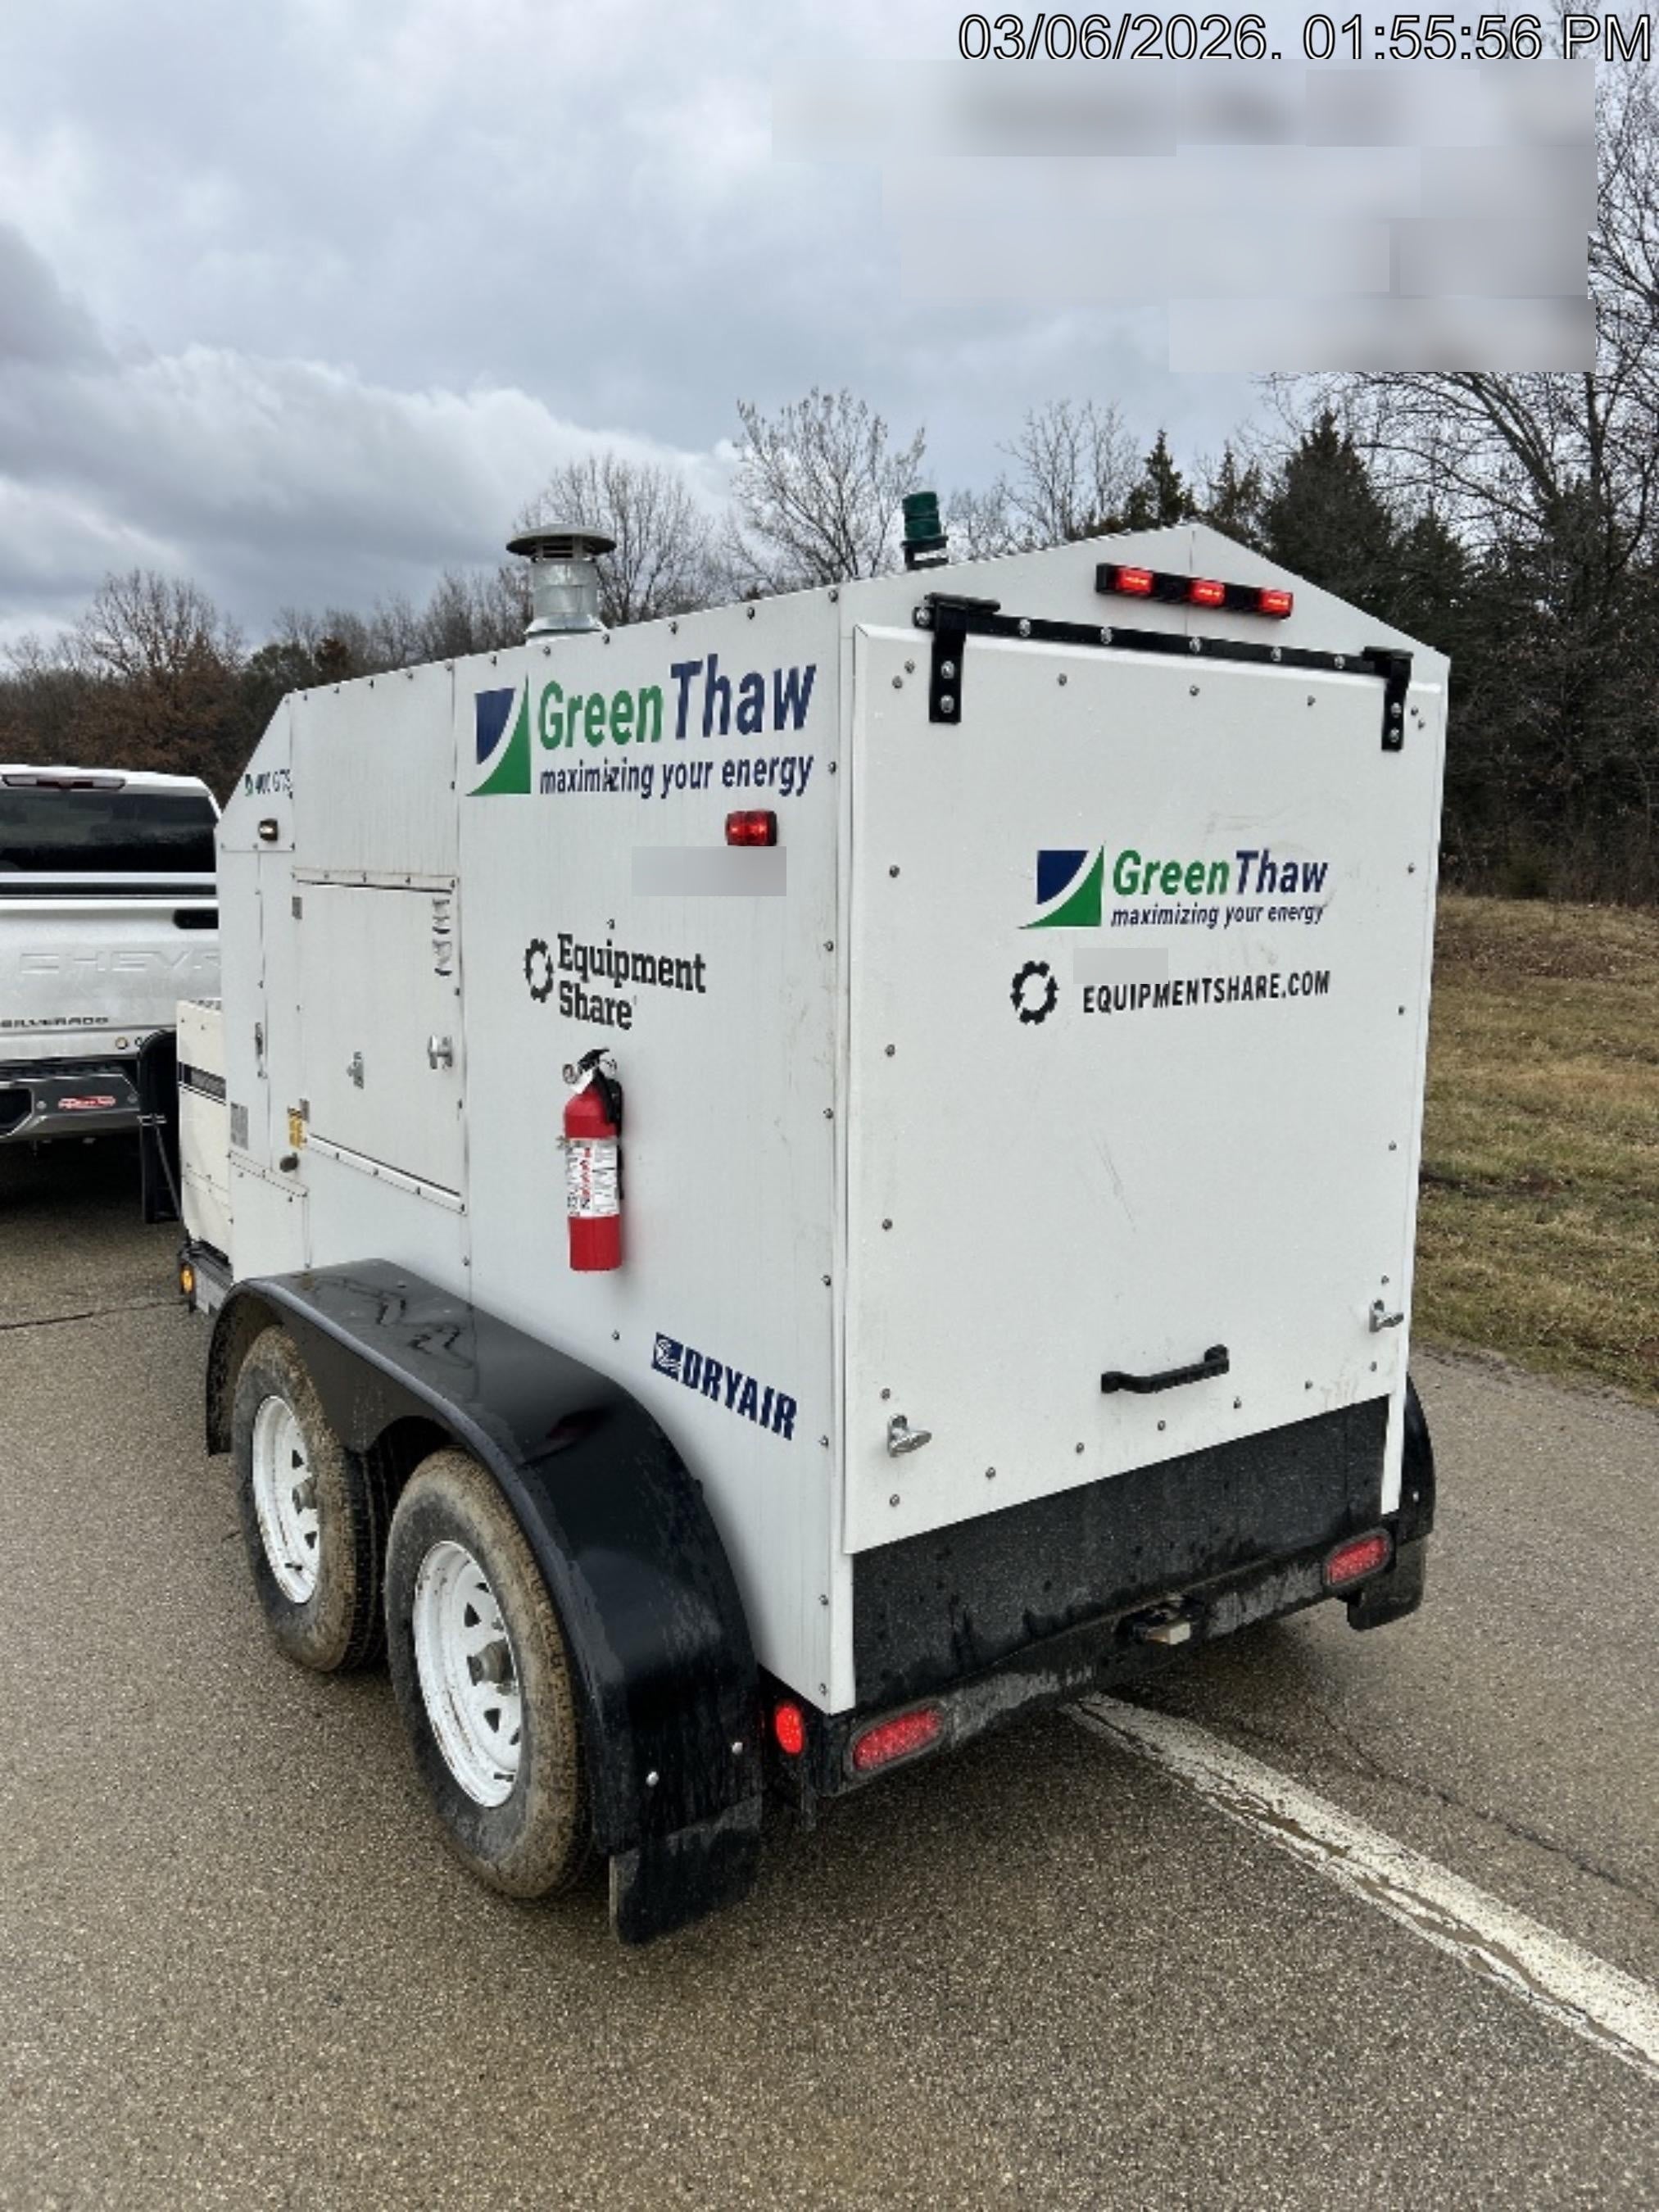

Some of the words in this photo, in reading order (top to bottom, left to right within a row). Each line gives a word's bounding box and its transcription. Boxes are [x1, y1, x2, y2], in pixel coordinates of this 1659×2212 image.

[539, 756, 655, 800] maximizing
[661, 759, 714, 800] your
[721, 754, 815, 798] energy
[1110, 902, 1220, 930] maximizing
[1223, 904, 1265, 929] your
[1267, 904, 1326, 926] energy
[557, 932, 707, 995] Equipment
[559, 980, 633, 1031] Share
[1082, 970, 1330, 1014] EQUIPMENTSHARE.COM
[681, 1345, 797, 1441] DRYAIR
